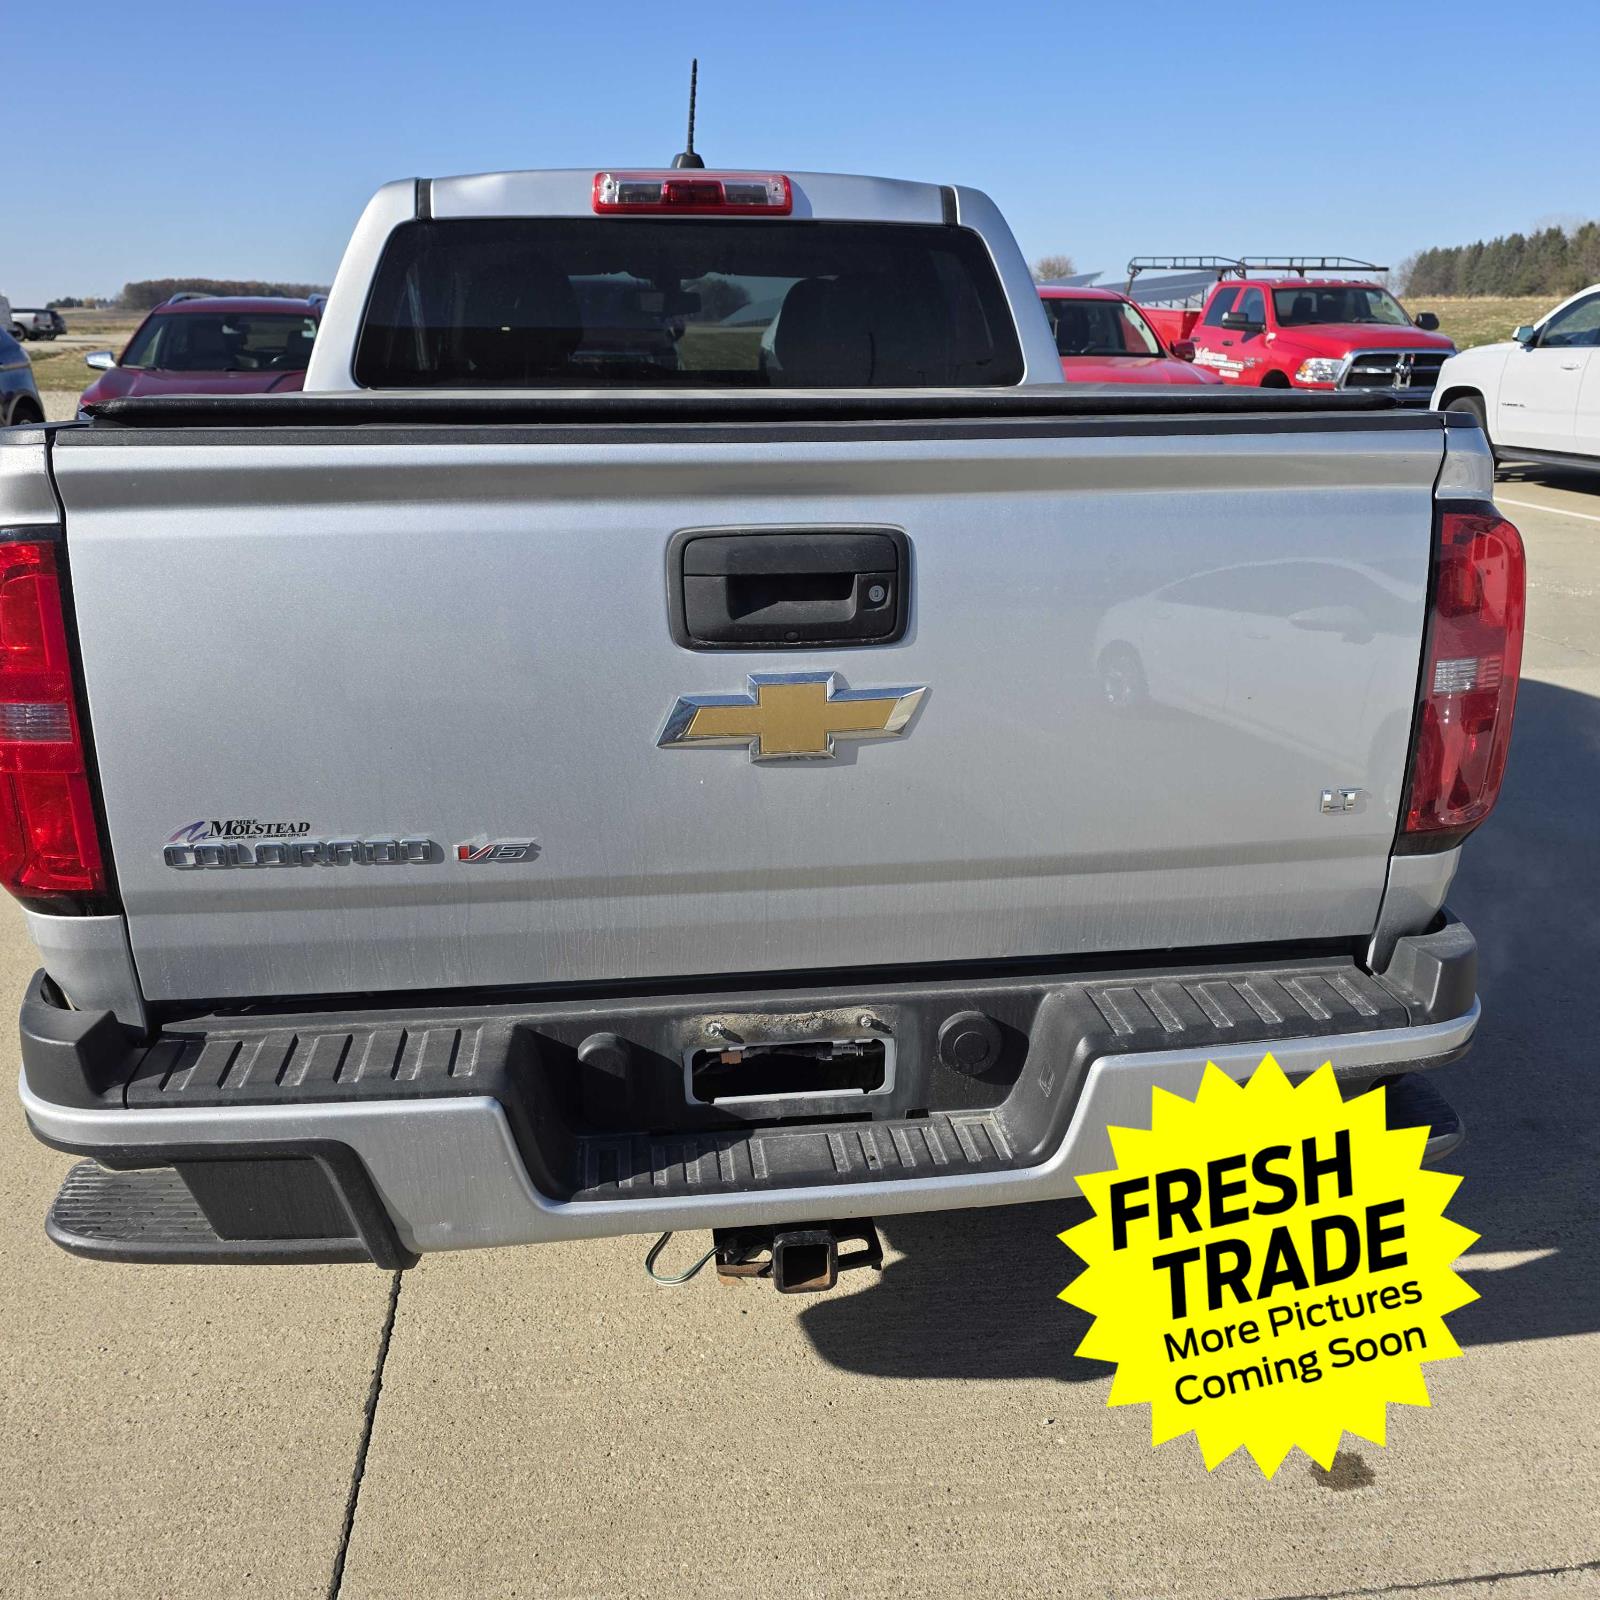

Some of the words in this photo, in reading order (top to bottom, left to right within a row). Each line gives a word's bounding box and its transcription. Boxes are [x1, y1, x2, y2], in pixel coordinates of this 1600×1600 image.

[1320, 789, 1363, 813] LT
[207, 820, 311, 836] MOLSTEAD
[163, 838, 431, 868] COLORADO
[453, 842, 532, 861] V6
